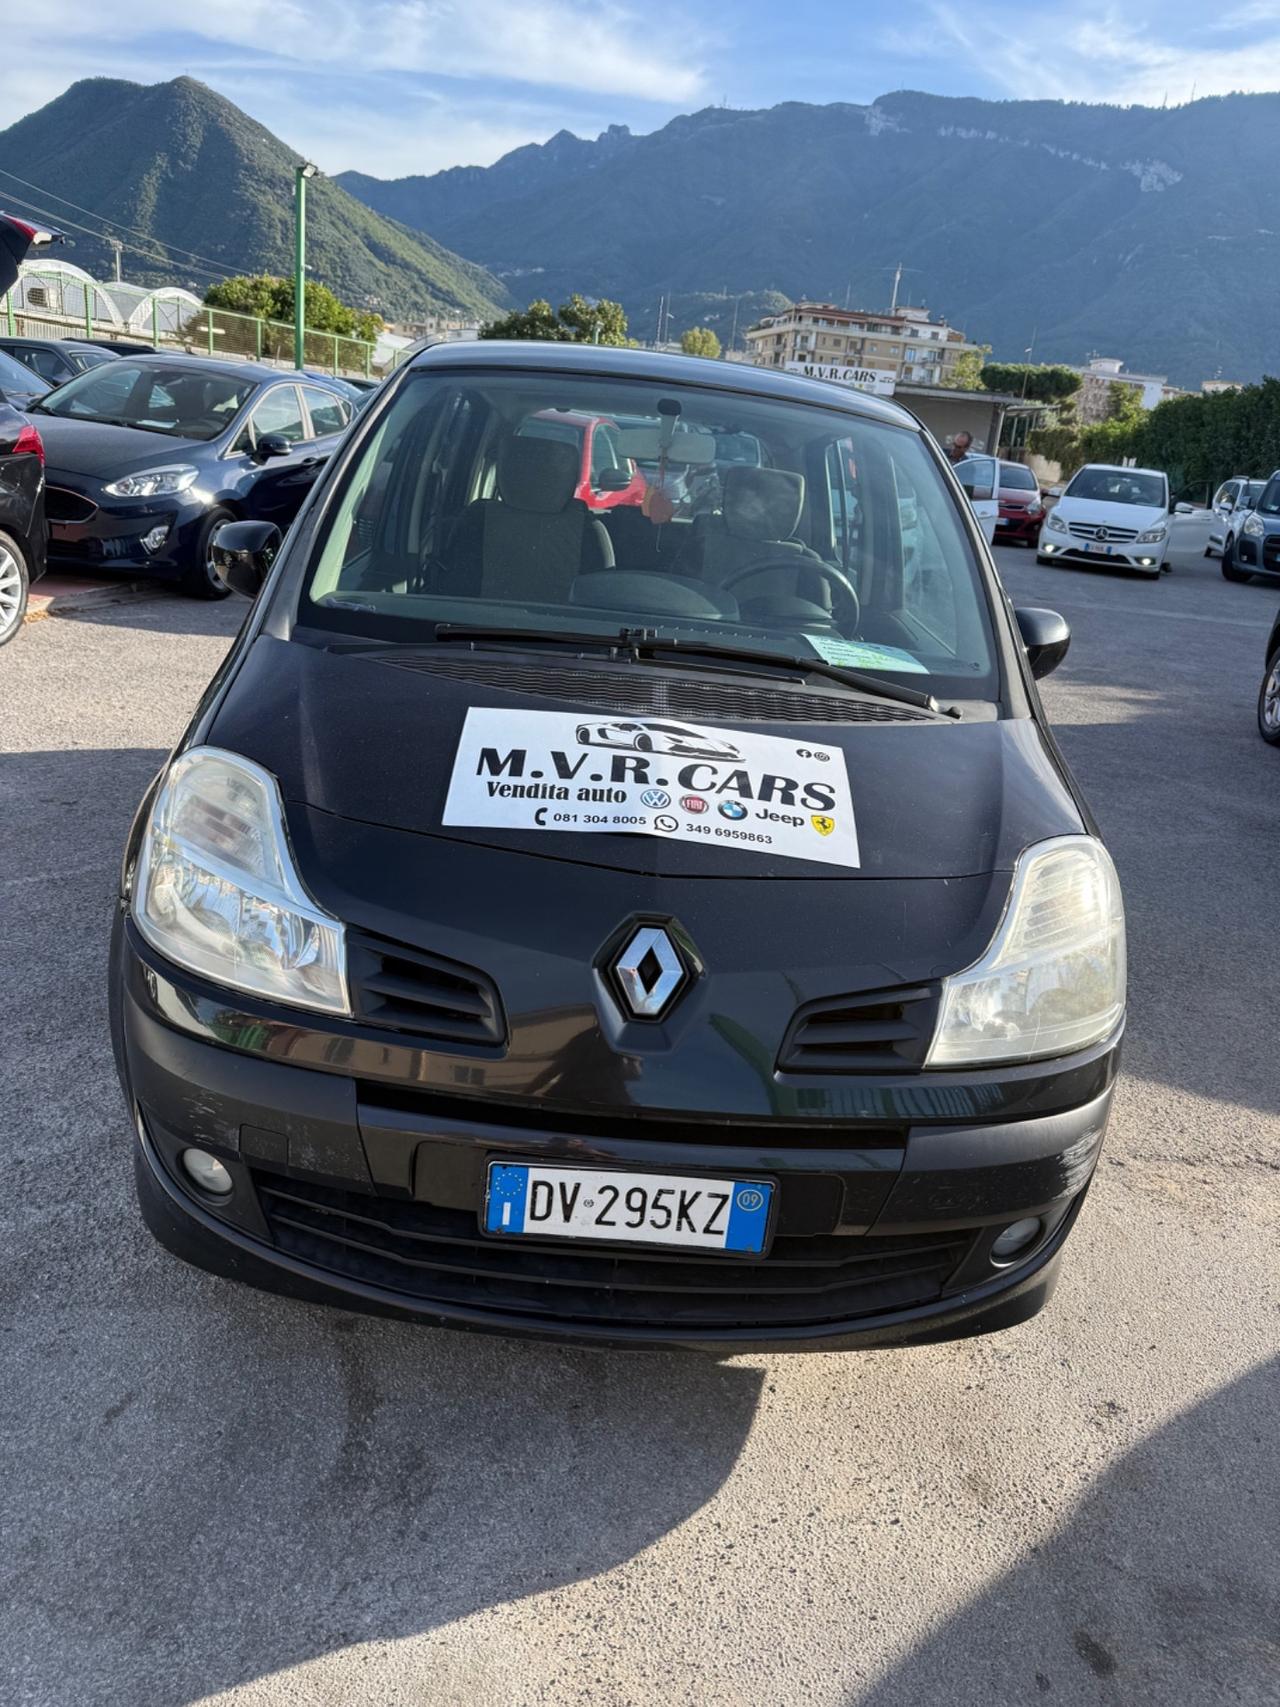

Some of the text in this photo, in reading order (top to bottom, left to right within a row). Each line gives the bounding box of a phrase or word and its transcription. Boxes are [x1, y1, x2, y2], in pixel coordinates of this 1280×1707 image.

[487, 781, 627, 803] Vendita auto
[553, 813, 647, 825] 081 304 8005
[755, 808, 805, 827] Jeep
[686, 823, 773, 844] 349 6959863
[529, 1180, 730, 1236] DV 295KZ
[741, 1193, 757, 1207] 09
